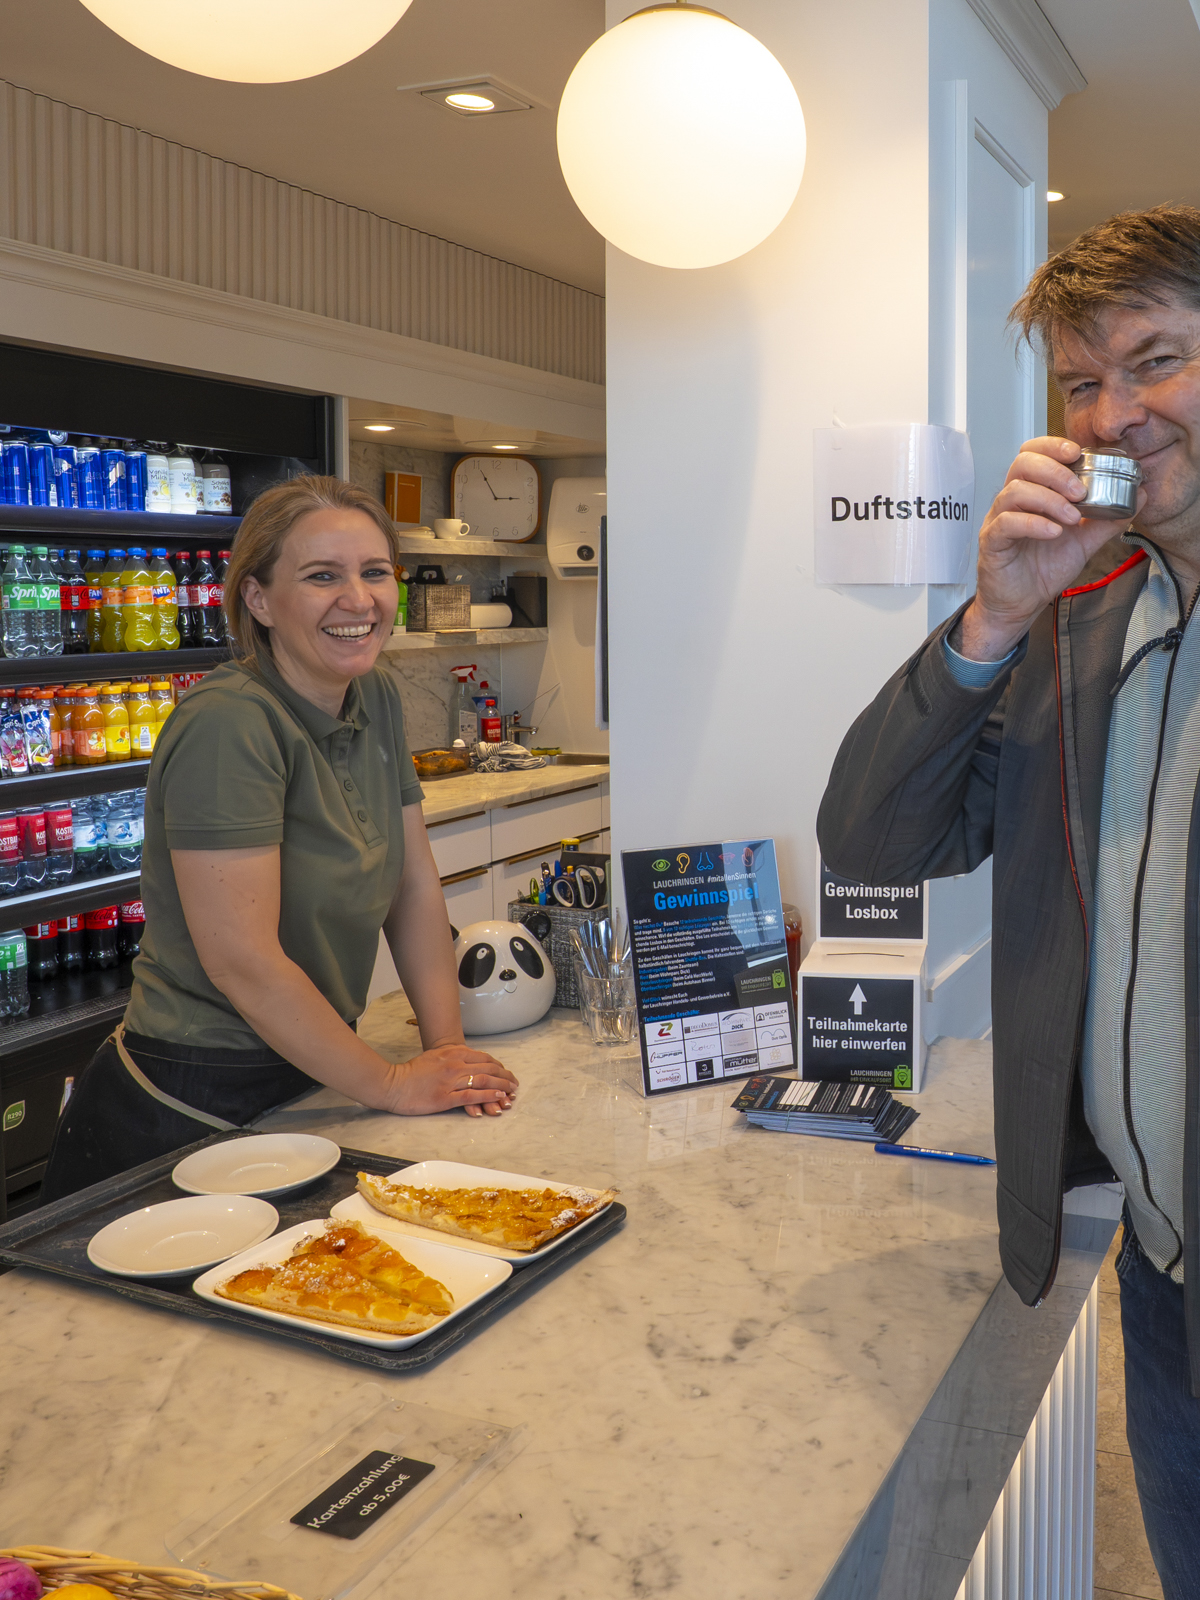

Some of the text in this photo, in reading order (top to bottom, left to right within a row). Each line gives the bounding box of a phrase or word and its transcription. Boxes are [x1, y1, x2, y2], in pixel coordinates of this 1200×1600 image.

[831, 494, 969, 522] Duftstation
[153, 586, 171, 596] ANTA
[653, 876, 705, 889] LAUCHRINGEN
[653, 882, 760, 911] Gewinnspiel
[825, 881, 920, 902] Gewinnspiel
[845, 904, 899, 920] Losbox
[807, 1016, 908, 1032] Teilnahmekarte
[812, 1035, 907, 1051] hier einwerfen
[850, 1069, 892, 1077] LAUCHRINGEN
[7, 1110, 23, 1121] R290
[307, 1454, 404, 1529] Kartenzahlung
[359, 1473, 410, 1516] ab 5,00€
